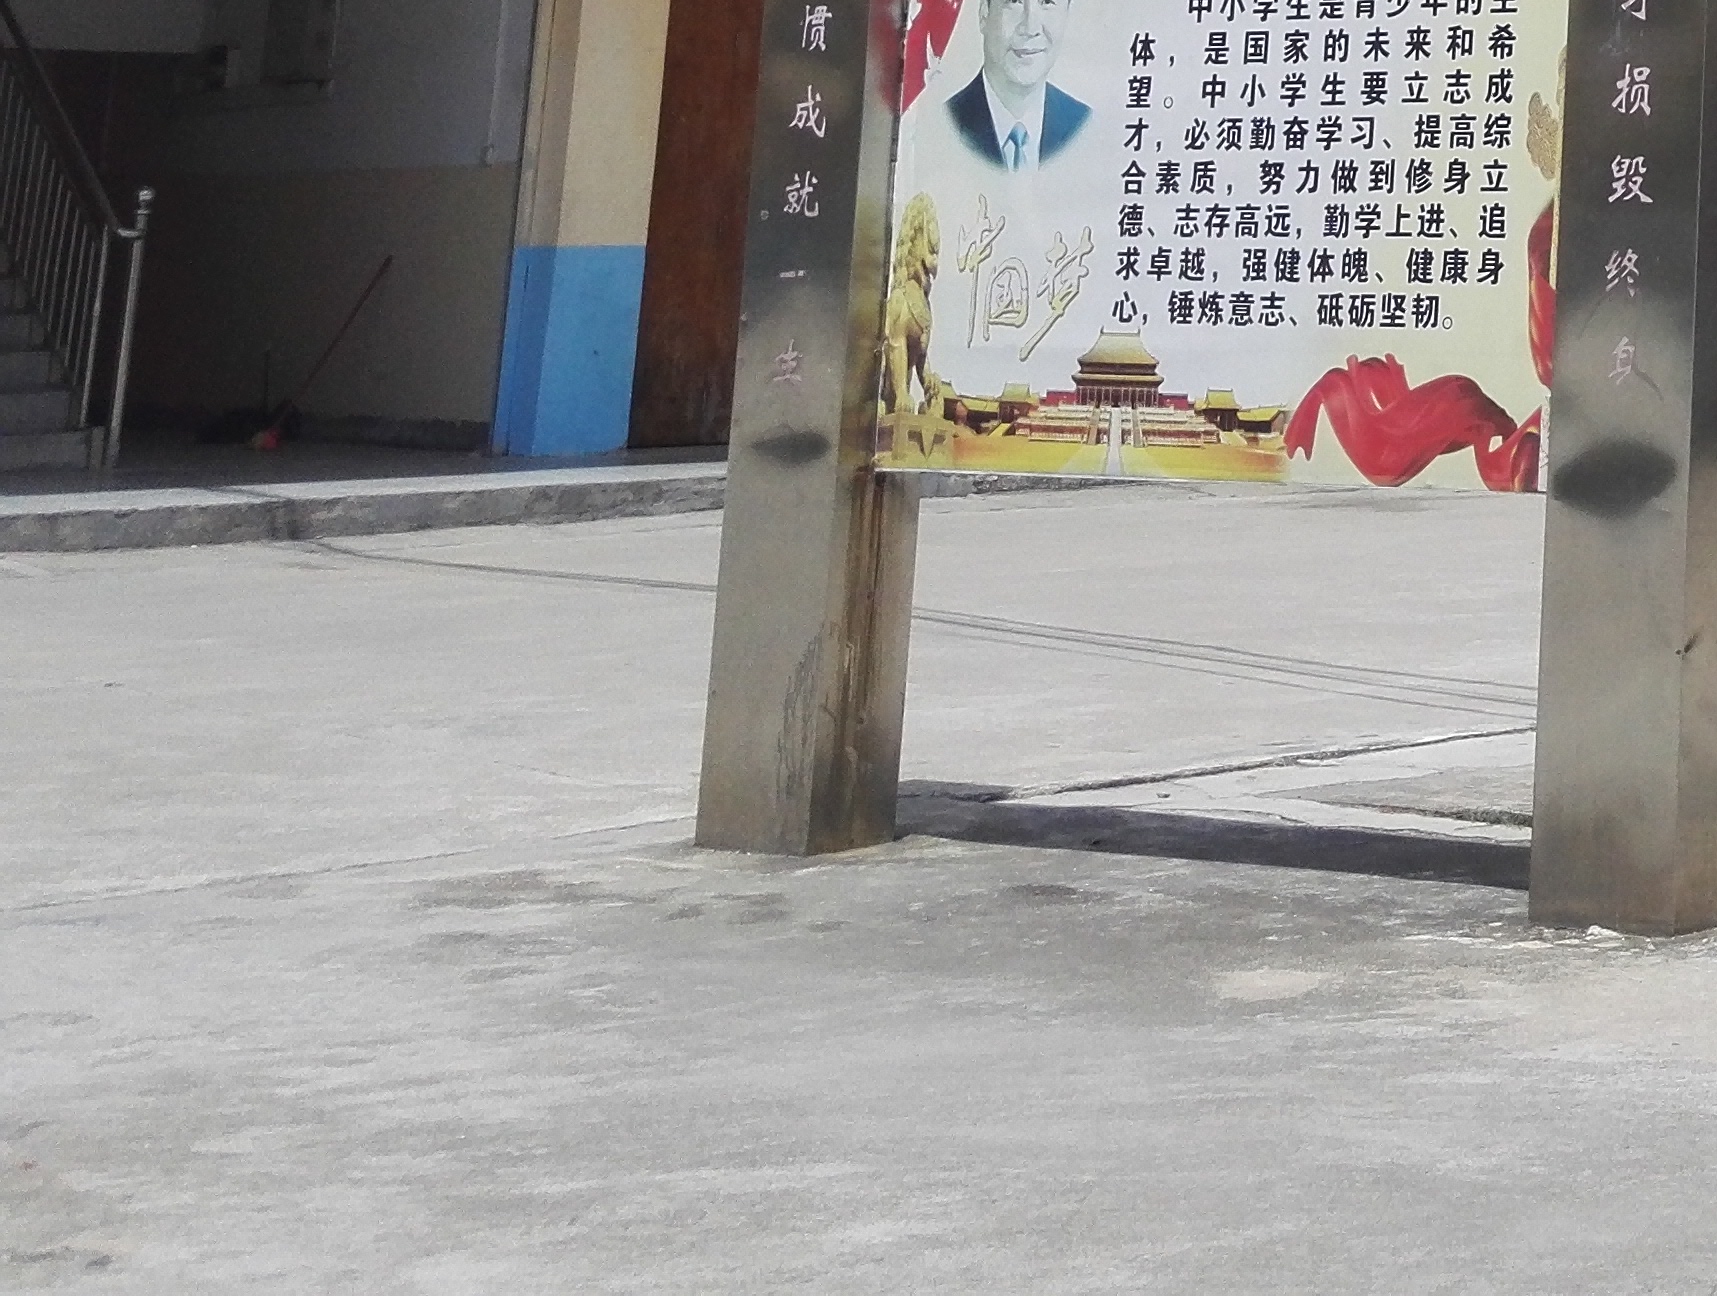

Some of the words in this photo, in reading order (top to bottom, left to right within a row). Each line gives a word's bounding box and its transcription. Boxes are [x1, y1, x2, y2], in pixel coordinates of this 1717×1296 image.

[1129, 23, 1518, 68] 体，是国家的未来和希
[1125, 68, 1515, 110] 望。中小学生要立志成
[1122, 113, 1513, 152] 才，必须勤奋学习、提高综
[1120, 158, 1510, 196] 合素质，努力做到修身立
[1117, 202, 1507, 240] 德、志存高远，勤学上进、追
[956, 193, 1095, 362] 中国梦
[1114, 246, 1506, 286] 求卓越，强健体魄、健康身
[1111, 290, 1454, 331] 心，锤炼意志、砥砺坚韧。
